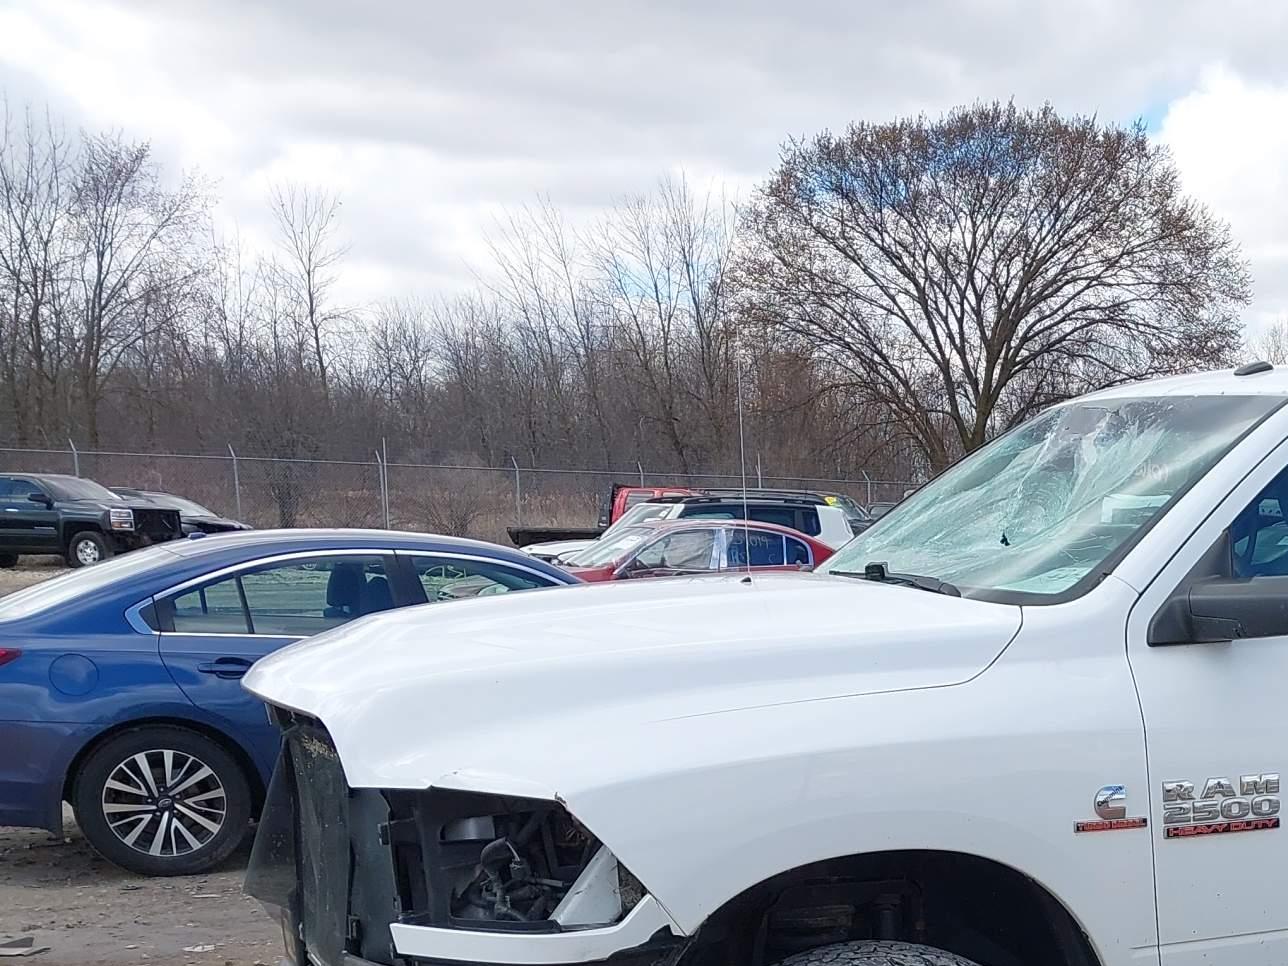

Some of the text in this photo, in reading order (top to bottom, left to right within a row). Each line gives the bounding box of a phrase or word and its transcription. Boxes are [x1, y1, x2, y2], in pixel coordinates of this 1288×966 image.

[1162, 773, 1280, 802] RAM
[1163, 795, 1280, 824] 2500
[1168, 818, 1279, 837] HEAVY DUTY
